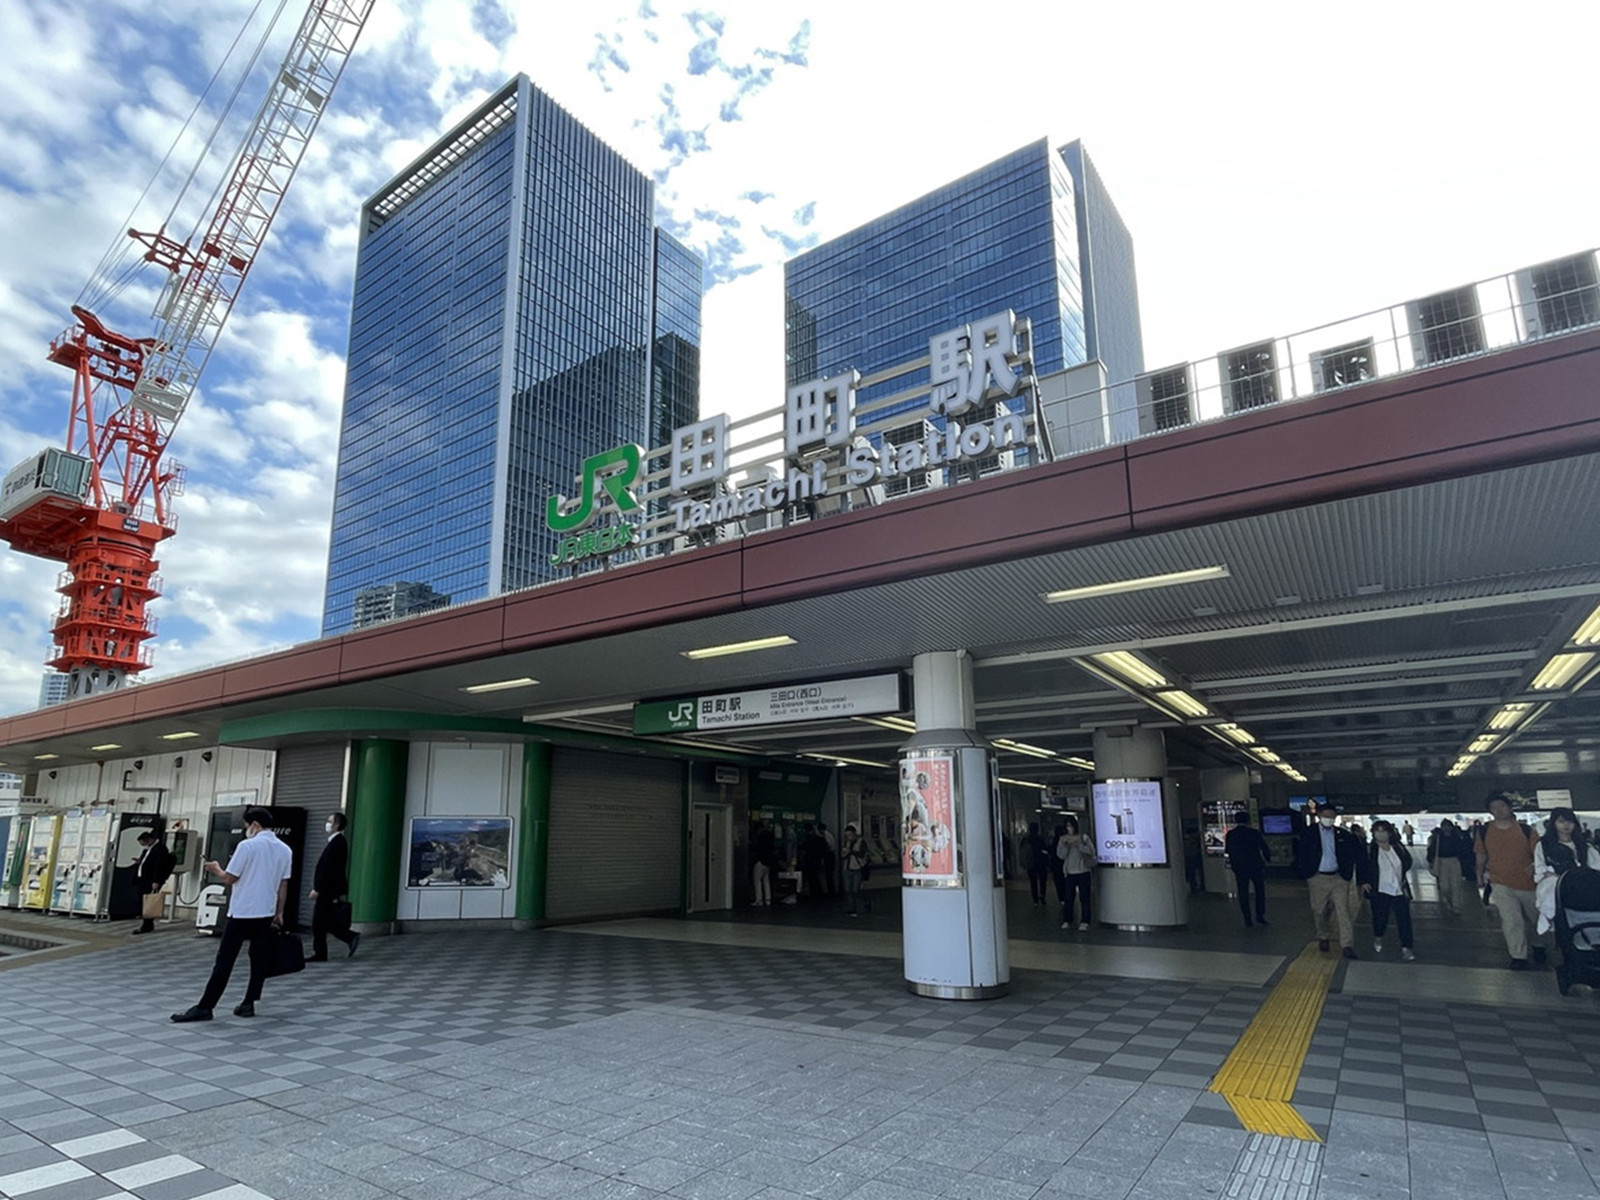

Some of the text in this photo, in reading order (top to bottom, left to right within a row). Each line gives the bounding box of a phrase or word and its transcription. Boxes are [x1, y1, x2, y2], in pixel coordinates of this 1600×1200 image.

[670, 309, 1019, 495] 田町駅
[546, 443, 643, 531] JR
[669, 414, 1026, 532] Tamachi Station
[549, 524, 636, 566] JR東日本
[702, 697, 742, 714] 田町駅
[770, 686, 822, 702] 三田口(西口)
[668, 702, 693, 721] JR
[702, 712, 760, 724] Tamachi Station
